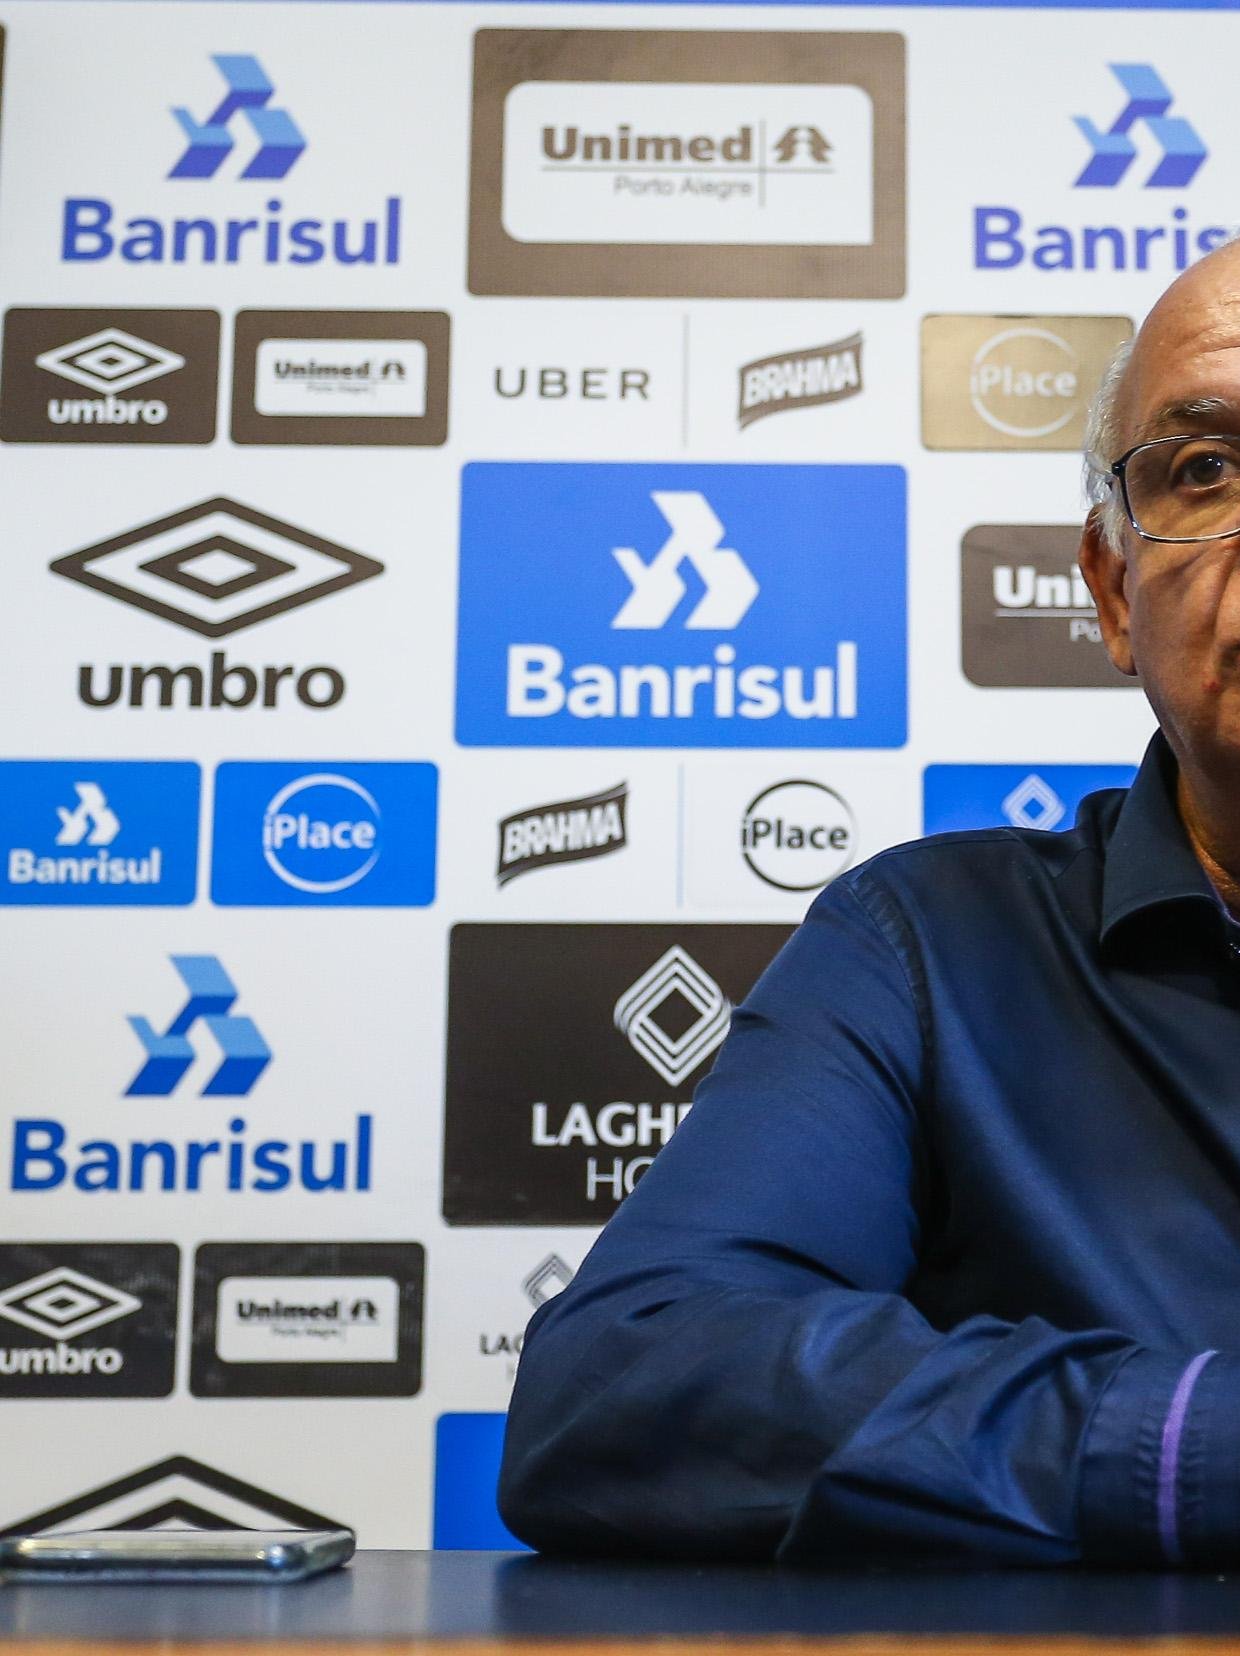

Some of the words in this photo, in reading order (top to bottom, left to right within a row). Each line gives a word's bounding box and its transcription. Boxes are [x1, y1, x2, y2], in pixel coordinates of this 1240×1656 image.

[542, 125, 752, 161] Unimed
[613, 175, 675, 196] Porto
[681, 175, 752, 200] Alegre
[61, 196, 402, 265] Banrisul
[494, 366, 651, 400] UBER
[743, 349, 861, 410] BRAHMA
[47, 394, 167, 425] umbro
[992, 563, 1098, 609] Uni
[77, 650, 346, 709] umbro
[506, 641, 858, 719] Banrisul
[503, 801, 623, 864] BRAHMA
[742, 817, 849, 850] iPlace
[8, 847, 162, 884] Banrisul
[10, 1113, 373, 1193] Banrisul
[237, 1299, 339, 1321] Unimed
[0, 1343, 124, 1375] umbro
